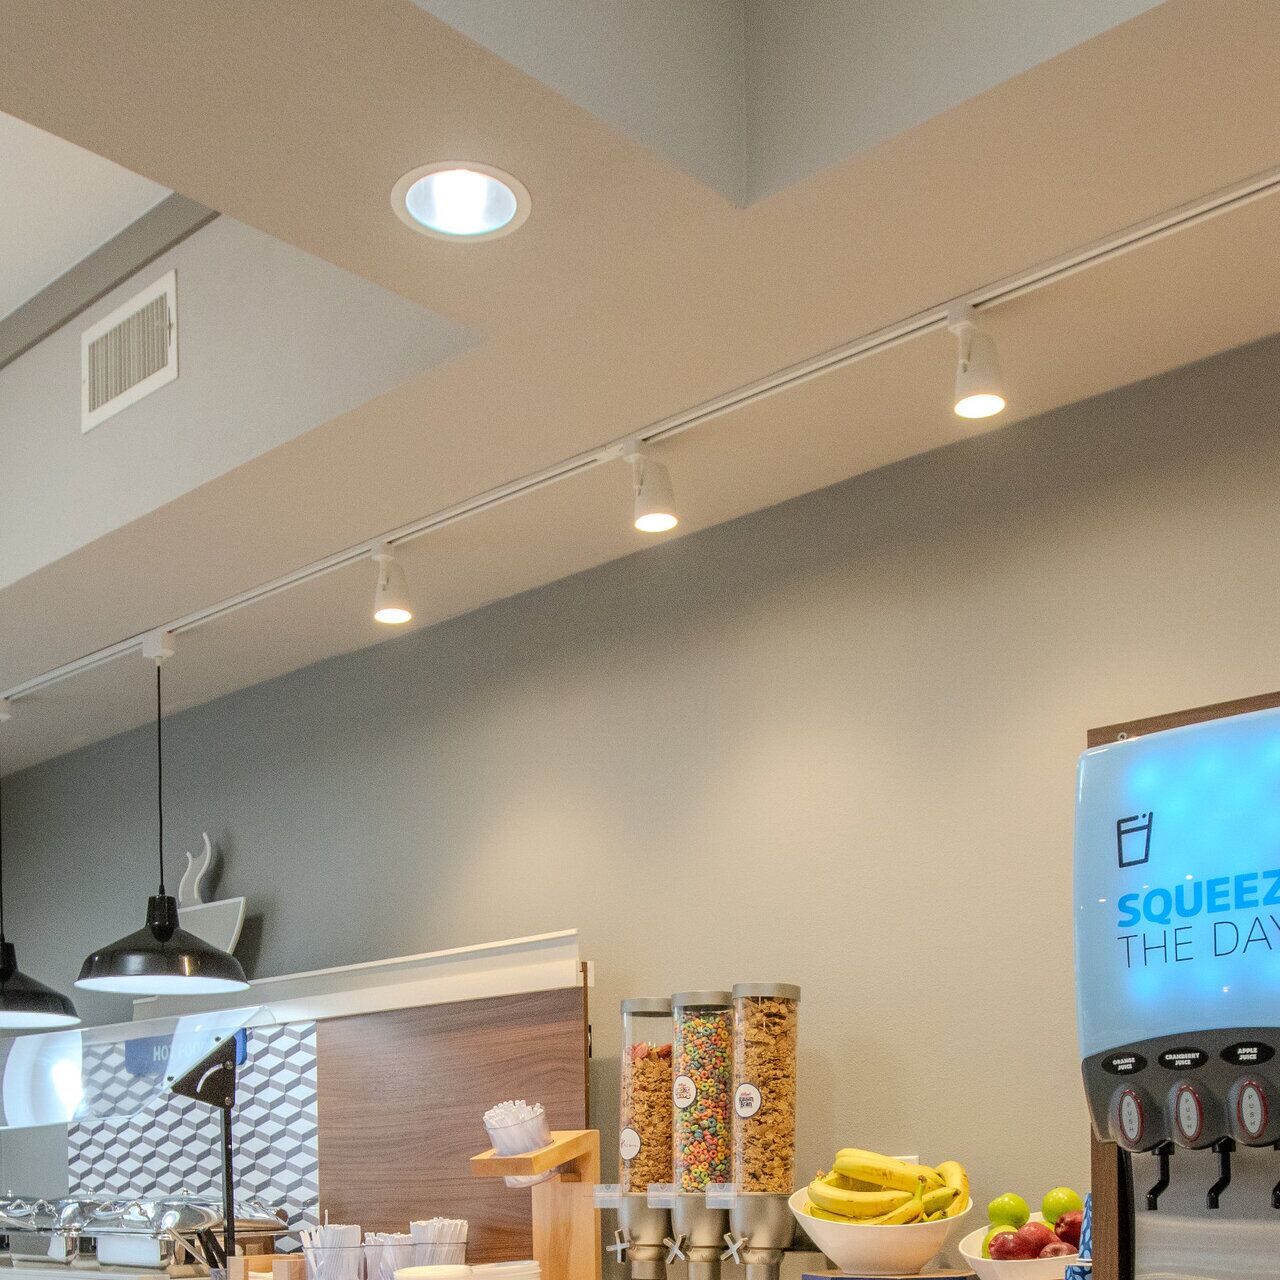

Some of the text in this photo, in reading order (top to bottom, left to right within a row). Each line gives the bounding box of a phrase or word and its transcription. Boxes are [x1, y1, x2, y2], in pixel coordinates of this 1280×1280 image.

[1117, 926, 1194, 968] THE
[1165, 1052, 1200, 1060] CRANBERRY
[1112, 1057, 1136, 1065] ORANGE
